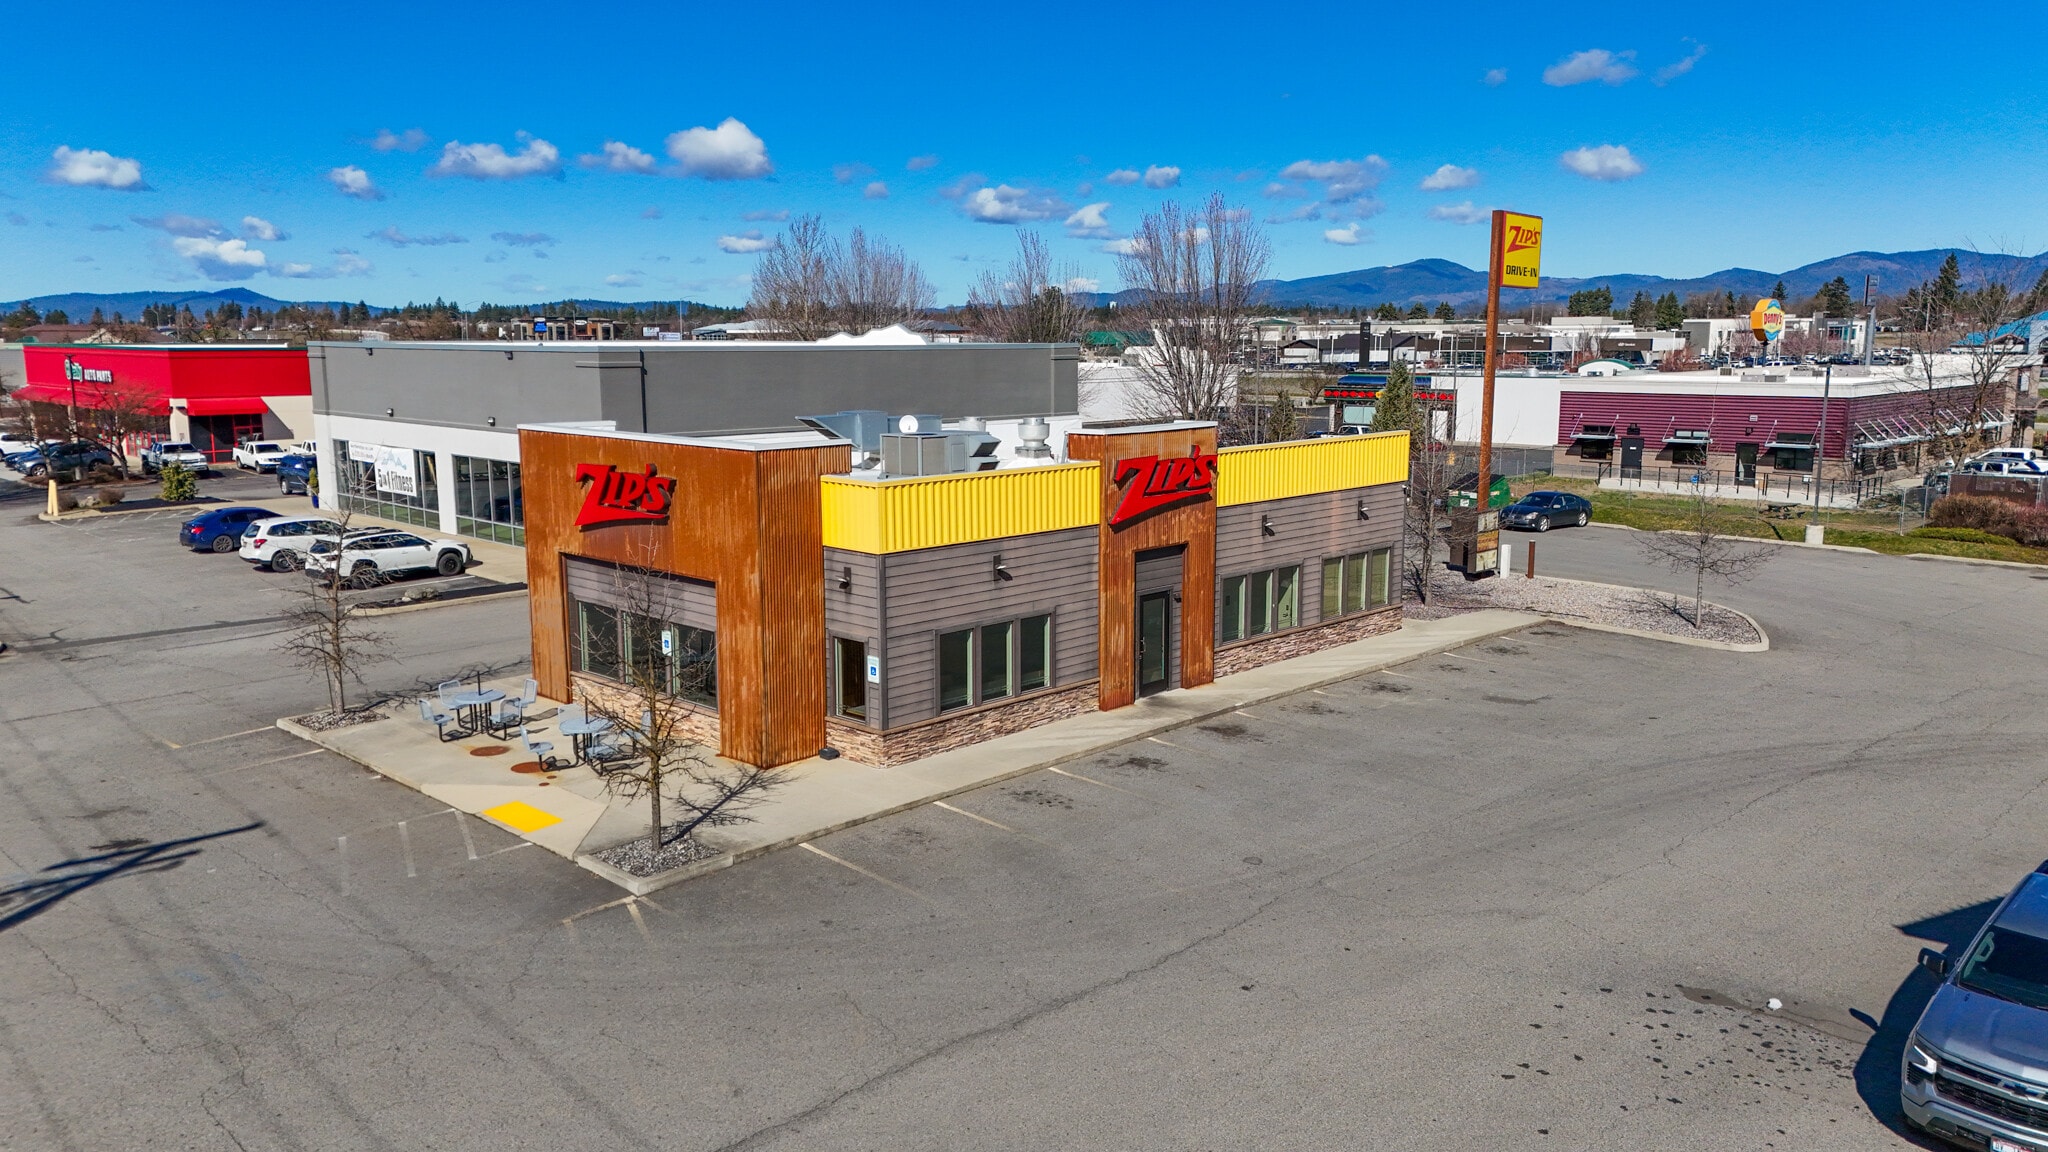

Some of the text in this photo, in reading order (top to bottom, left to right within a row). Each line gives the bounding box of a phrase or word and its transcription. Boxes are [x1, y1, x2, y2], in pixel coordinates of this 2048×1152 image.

[1505, 264, 1538, 278] DRIVE-IN
[1763, 313, 1783, 326] Denny's
[84, 369, 96, 382] AUTO
[96, 370, 112, 383] PARTS
[377, 468, 383, 488] 5
[391, 470, 414, 493] Fitness
